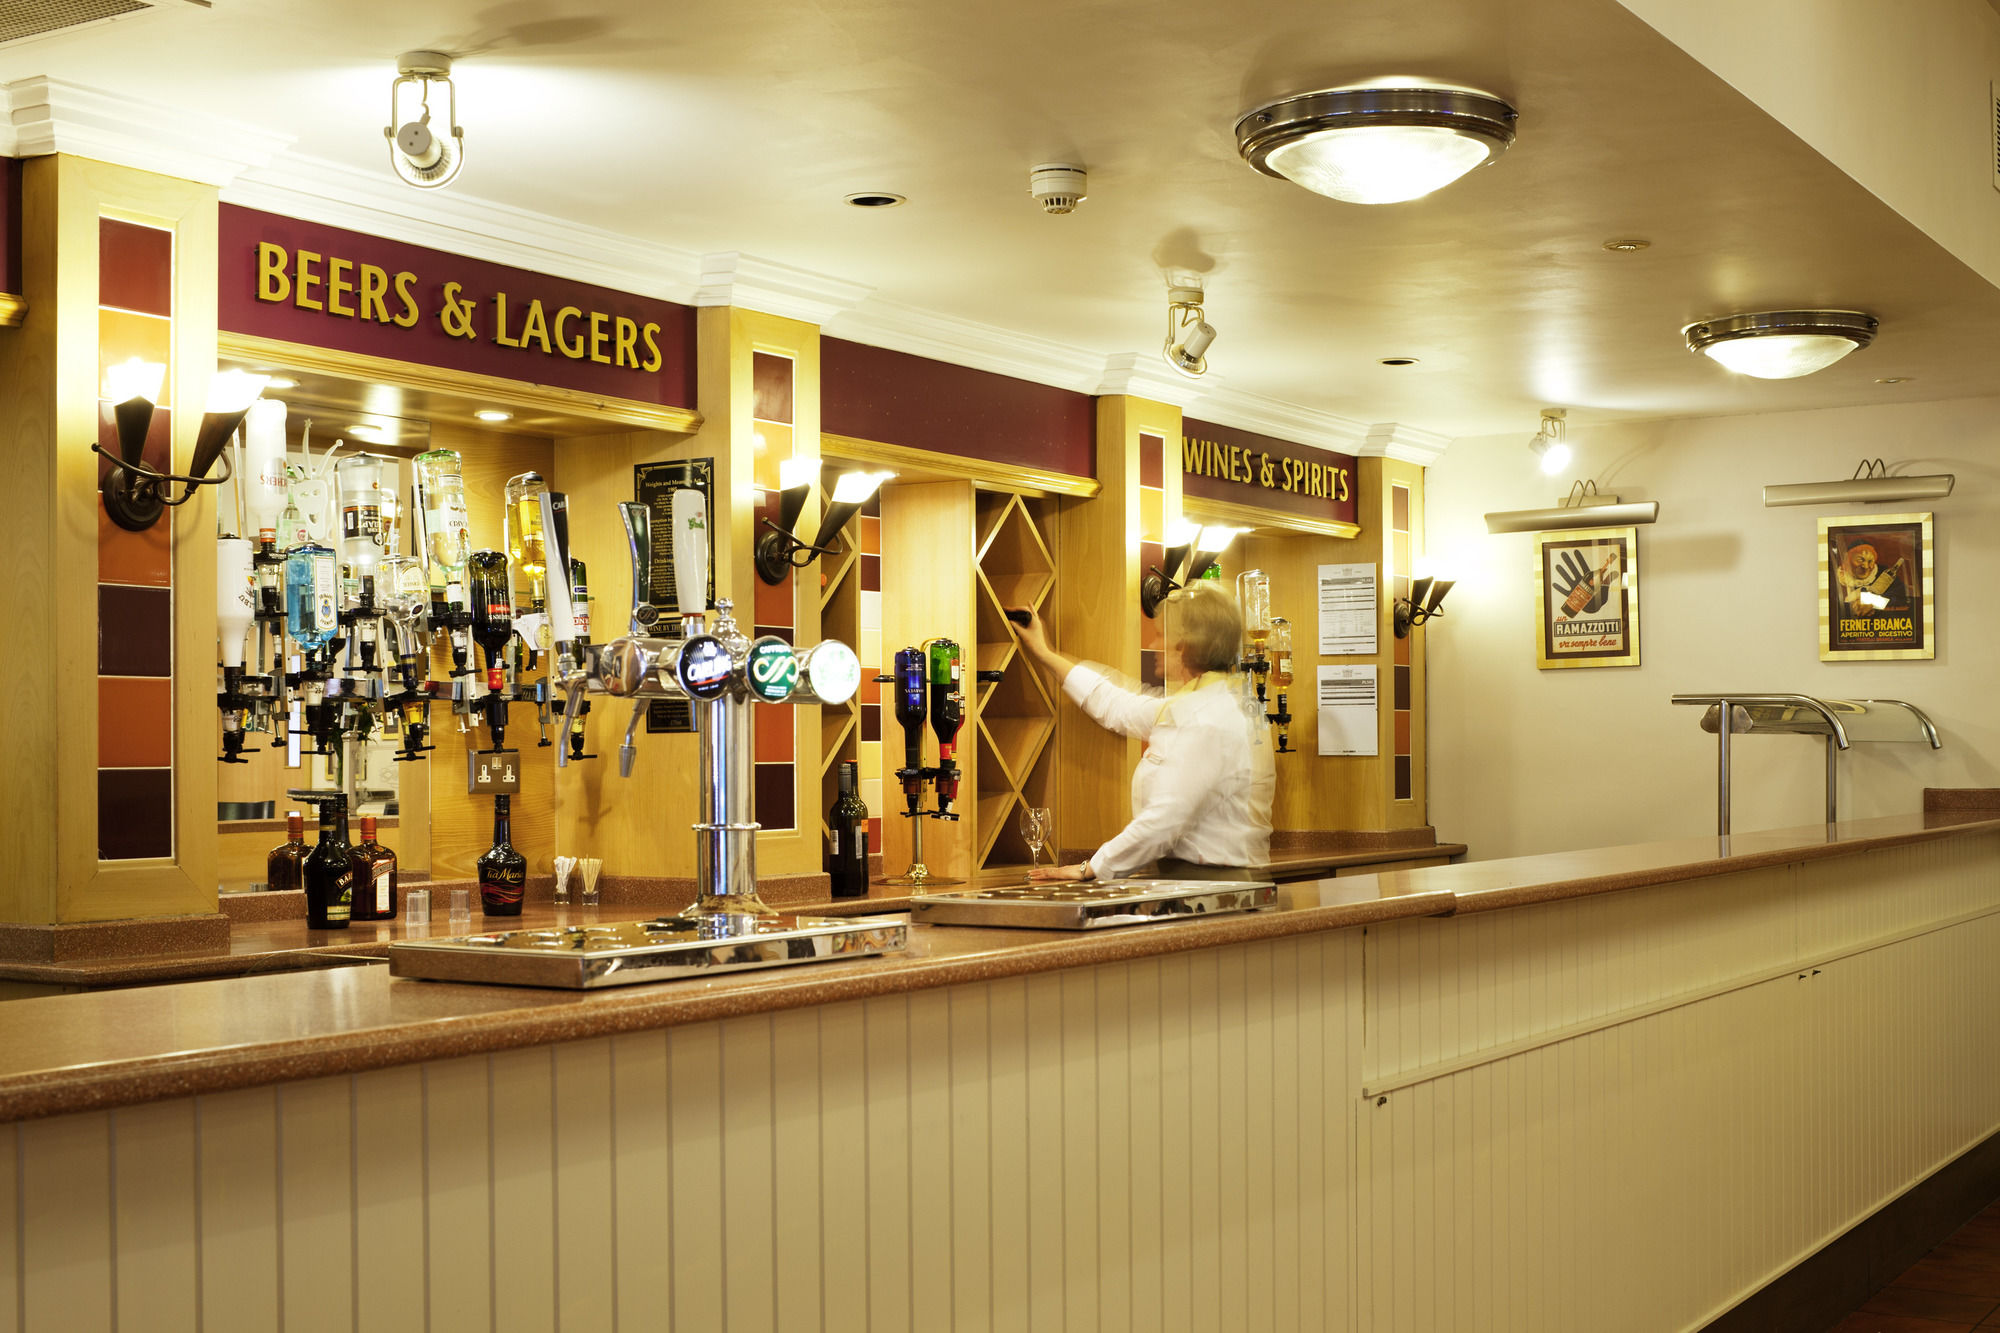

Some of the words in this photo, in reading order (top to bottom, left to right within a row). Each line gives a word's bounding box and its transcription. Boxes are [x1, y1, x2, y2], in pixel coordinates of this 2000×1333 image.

[258, 241, 419, 328] BEERS
[440, 282, 476, 340] &
[496, 292, 662, 373] LAGERS
[1183, 436, 1252, 484] WINES
[1260, 453, 1275, 488] &
[1282, 457, 1349, 502] SPIRITS
[1556, 621, 1619, 635] RAMAZZOTTI
[1599, 634, 1617, 646] bene
